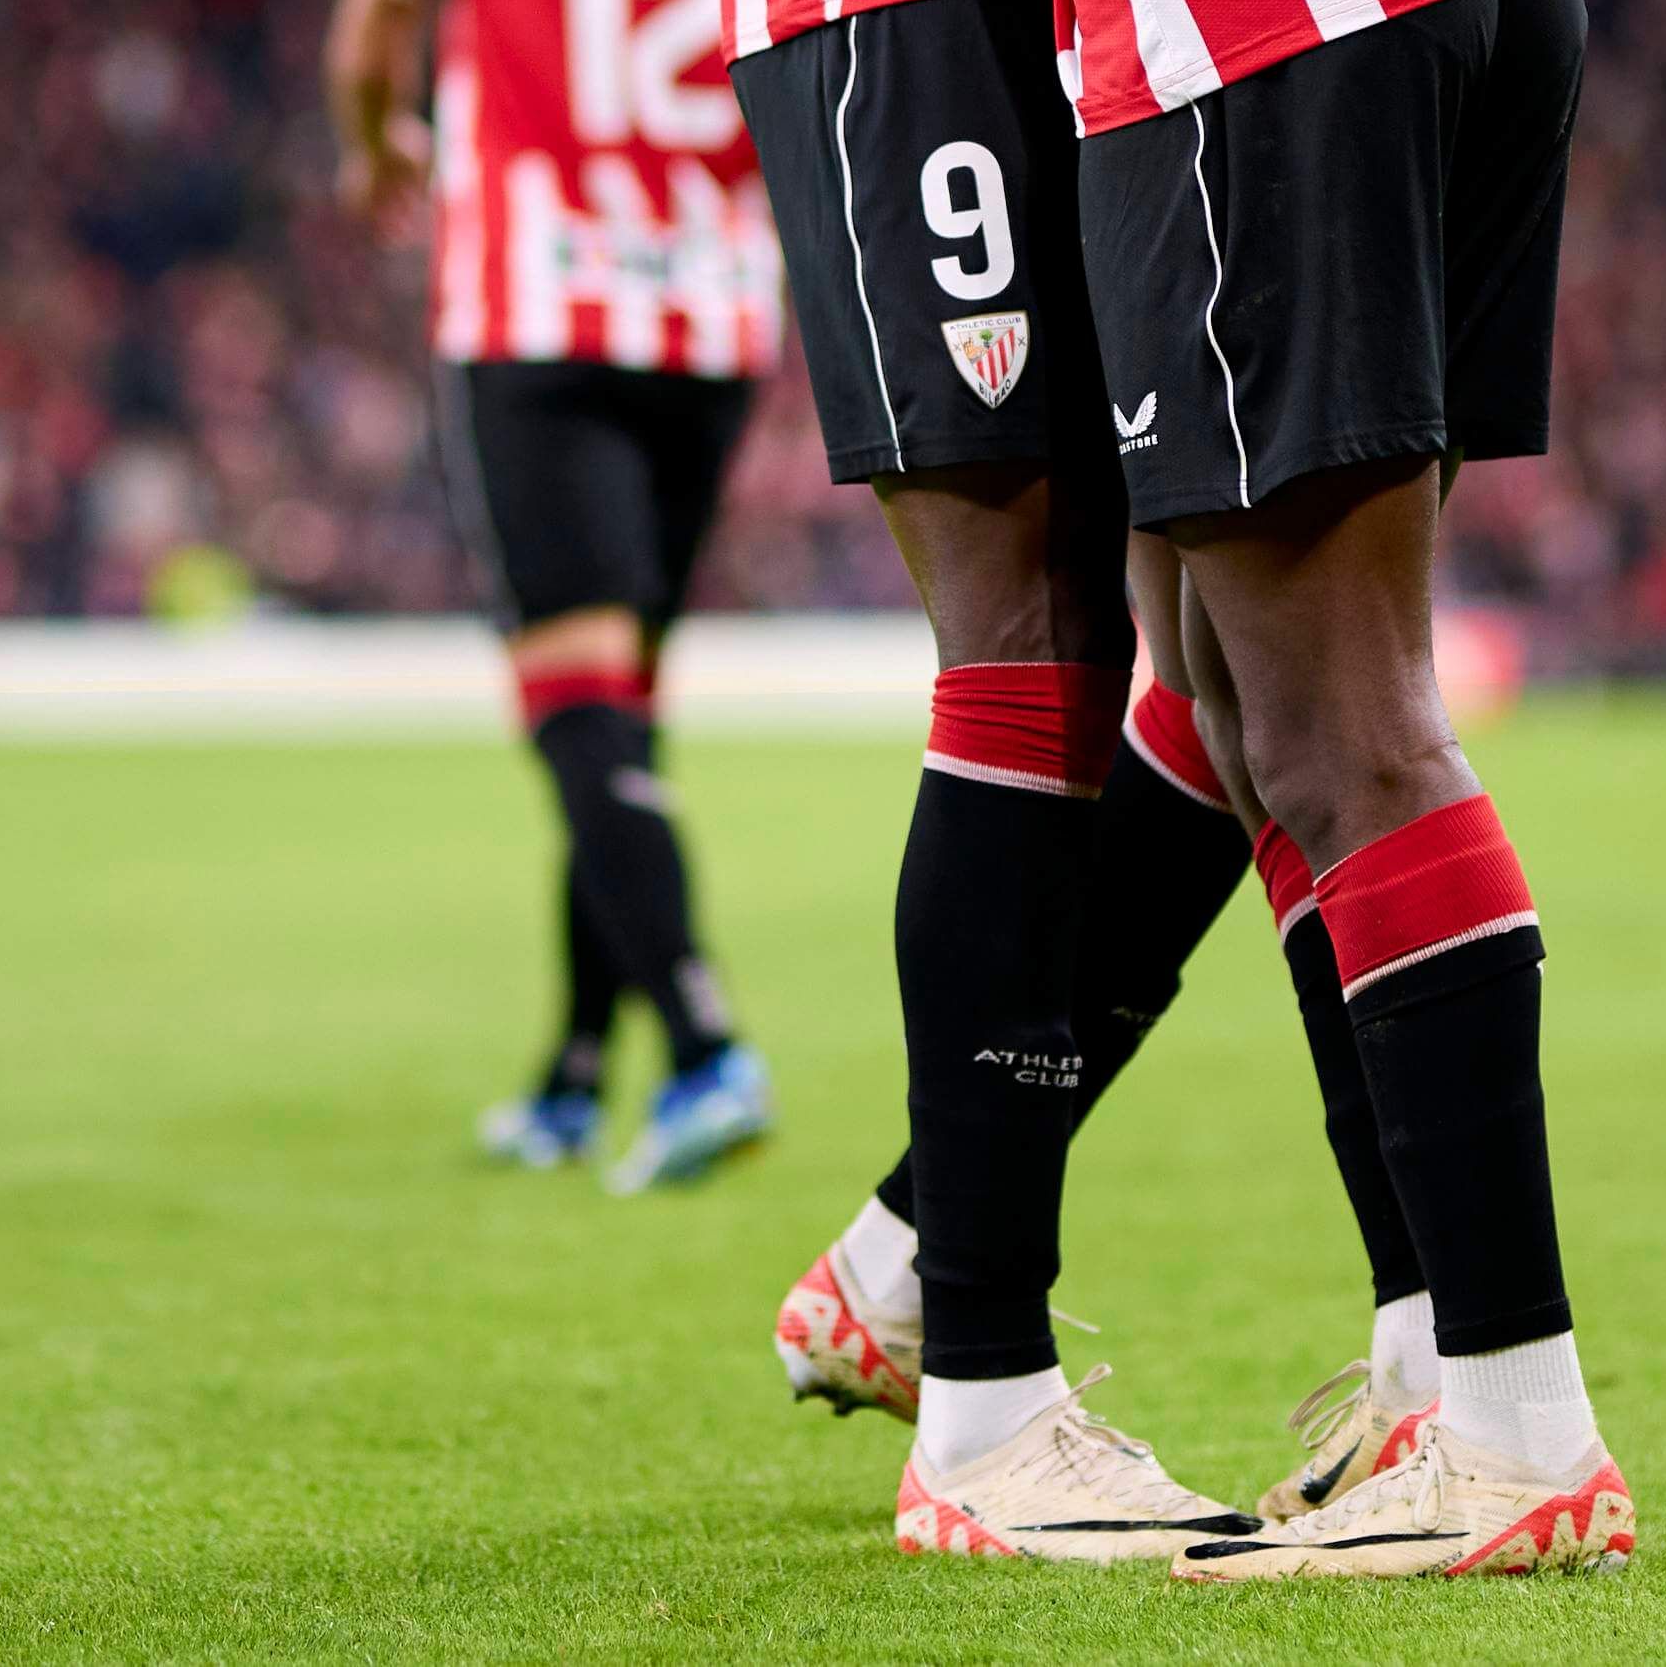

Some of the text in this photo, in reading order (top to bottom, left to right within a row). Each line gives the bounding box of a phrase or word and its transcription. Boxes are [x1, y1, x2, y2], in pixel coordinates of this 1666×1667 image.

[920, 140, 1015, 301] 9
[950, 316, 1022, 331] ATHLETIC CLUB
